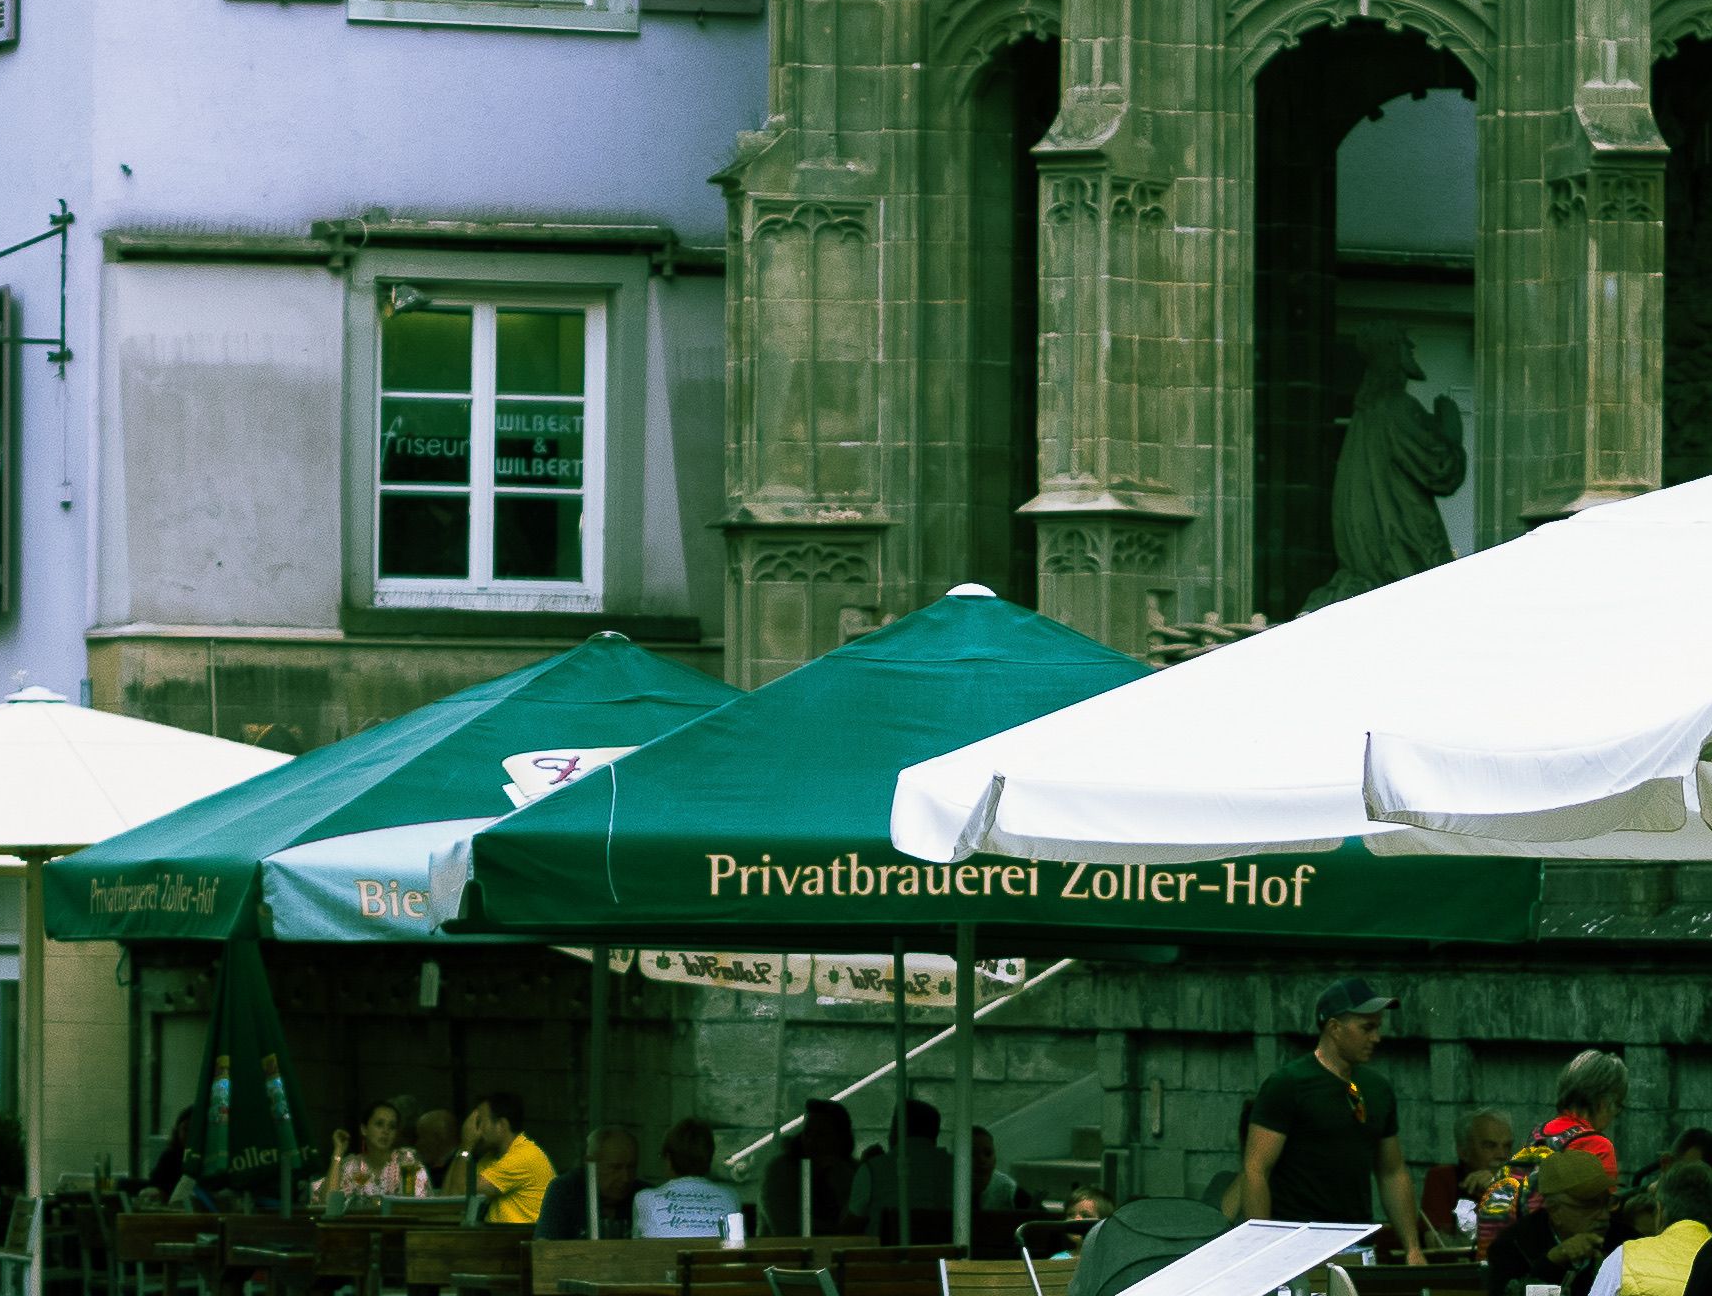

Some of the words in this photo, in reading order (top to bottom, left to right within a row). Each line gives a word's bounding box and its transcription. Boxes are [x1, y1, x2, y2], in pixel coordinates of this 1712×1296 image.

[495, 414, 585, 433] WILBERT
[381, 415, 470, 466] friseur
[532, 436, 547, 454] &
[495, 457, 584, 477] WILBERT
[89, 873, 159, 914] Privatbrauerei
[161, 872, 220, 915] Zoller-Hof
[704, 852, 1039, 897] Privatbrauerei
[1060, 857, 1316, 907] Zoller-Hof
